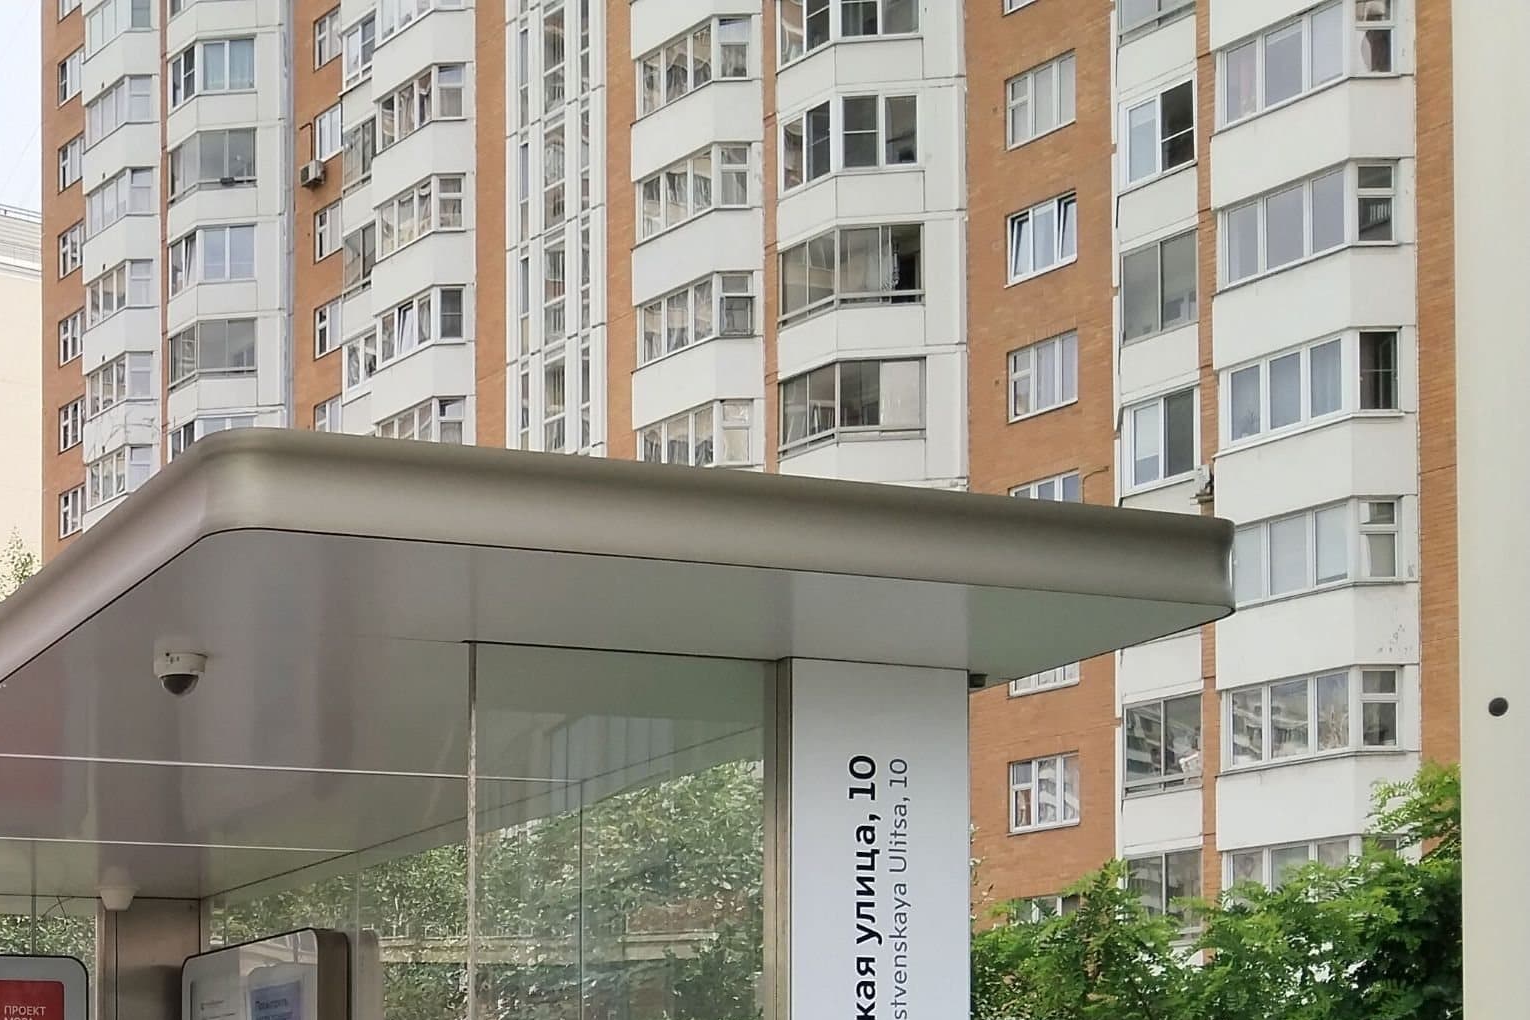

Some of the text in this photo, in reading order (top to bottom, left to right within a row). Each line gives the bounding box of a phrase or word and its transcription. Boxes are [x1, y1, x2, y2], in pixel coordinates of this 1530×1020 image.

[848, 755, 876, 801] 10
[889, 758, 908, 788] 10
[888, 797, 911, 873] Ulitsa,
[856, 813, 882, 946] улица,
[4, 1005, 46, 1017] ПРОЕКТ
